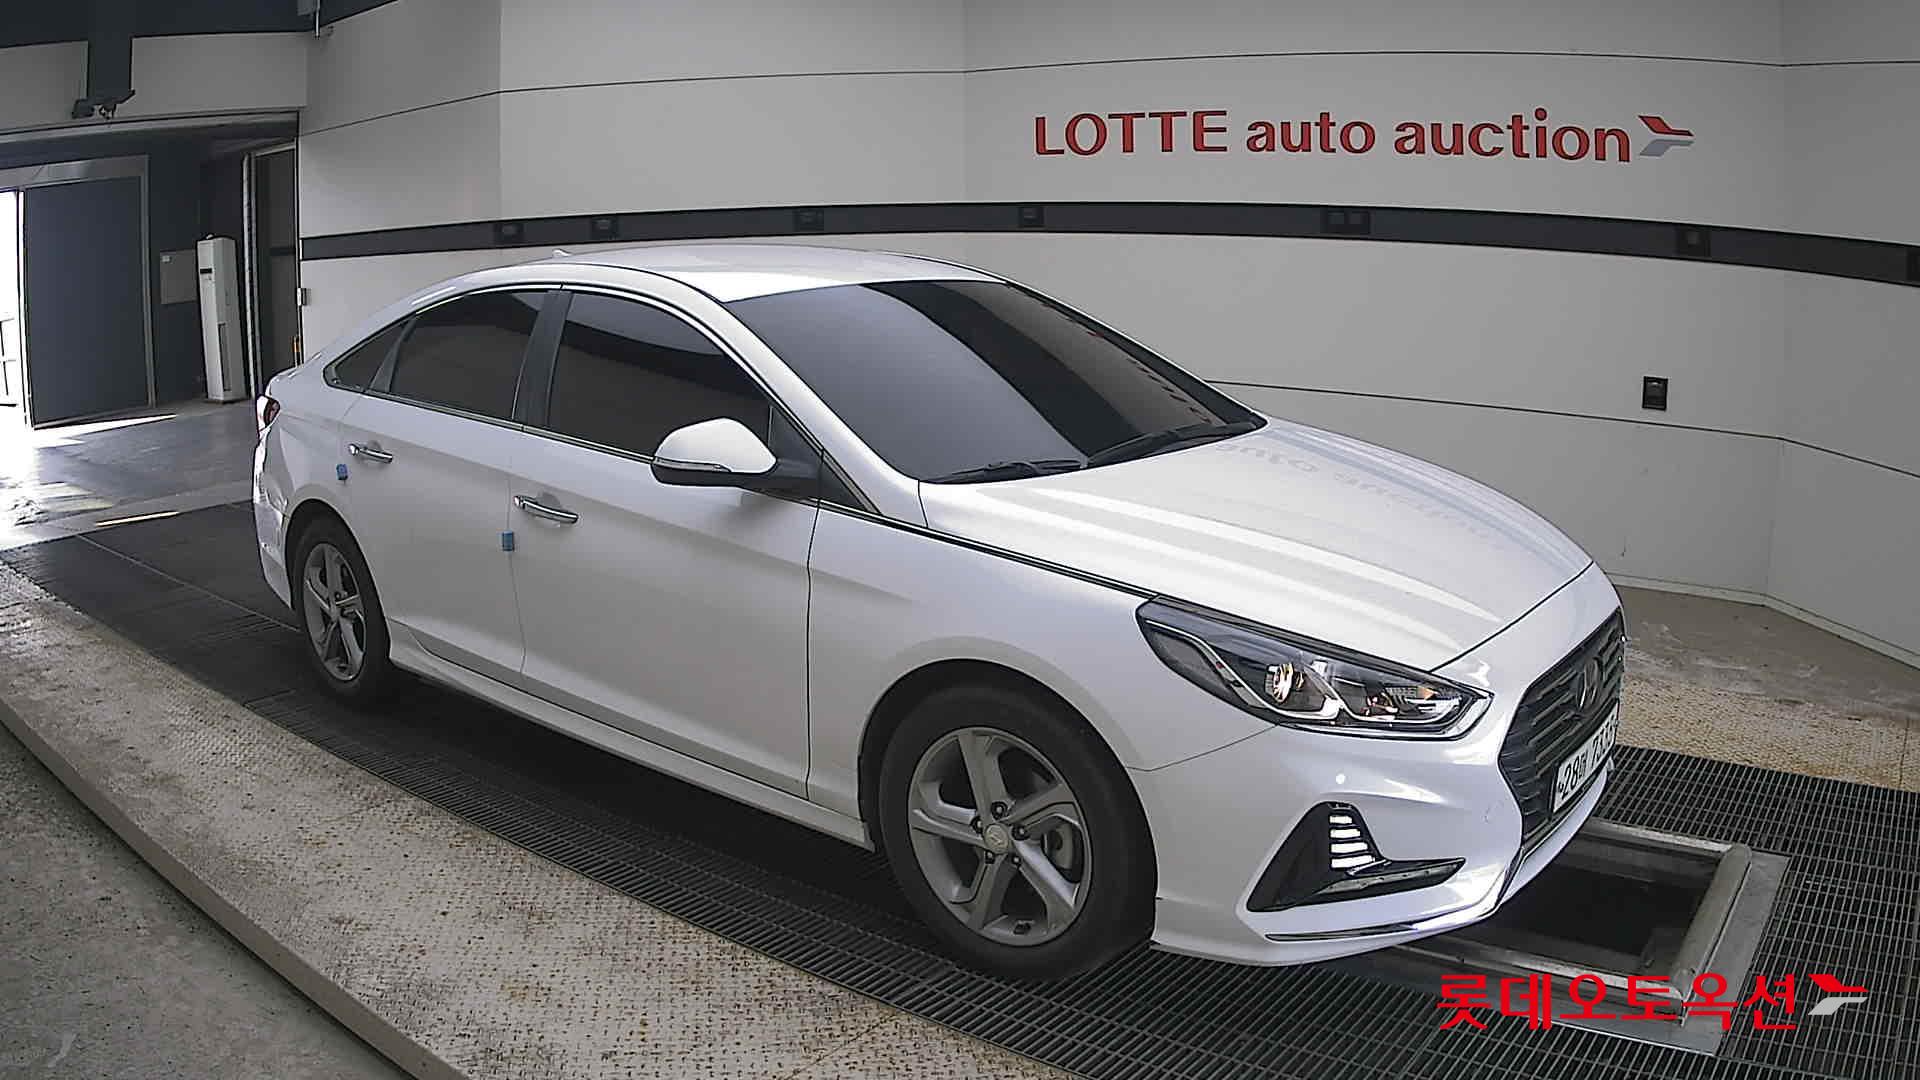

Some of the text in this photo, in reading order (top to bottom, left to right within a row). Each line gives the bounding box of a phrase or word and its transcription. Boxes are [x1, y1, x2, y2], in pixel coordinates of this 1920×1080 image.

[1035, 108, 1631, 162] LOTTE auto auction
